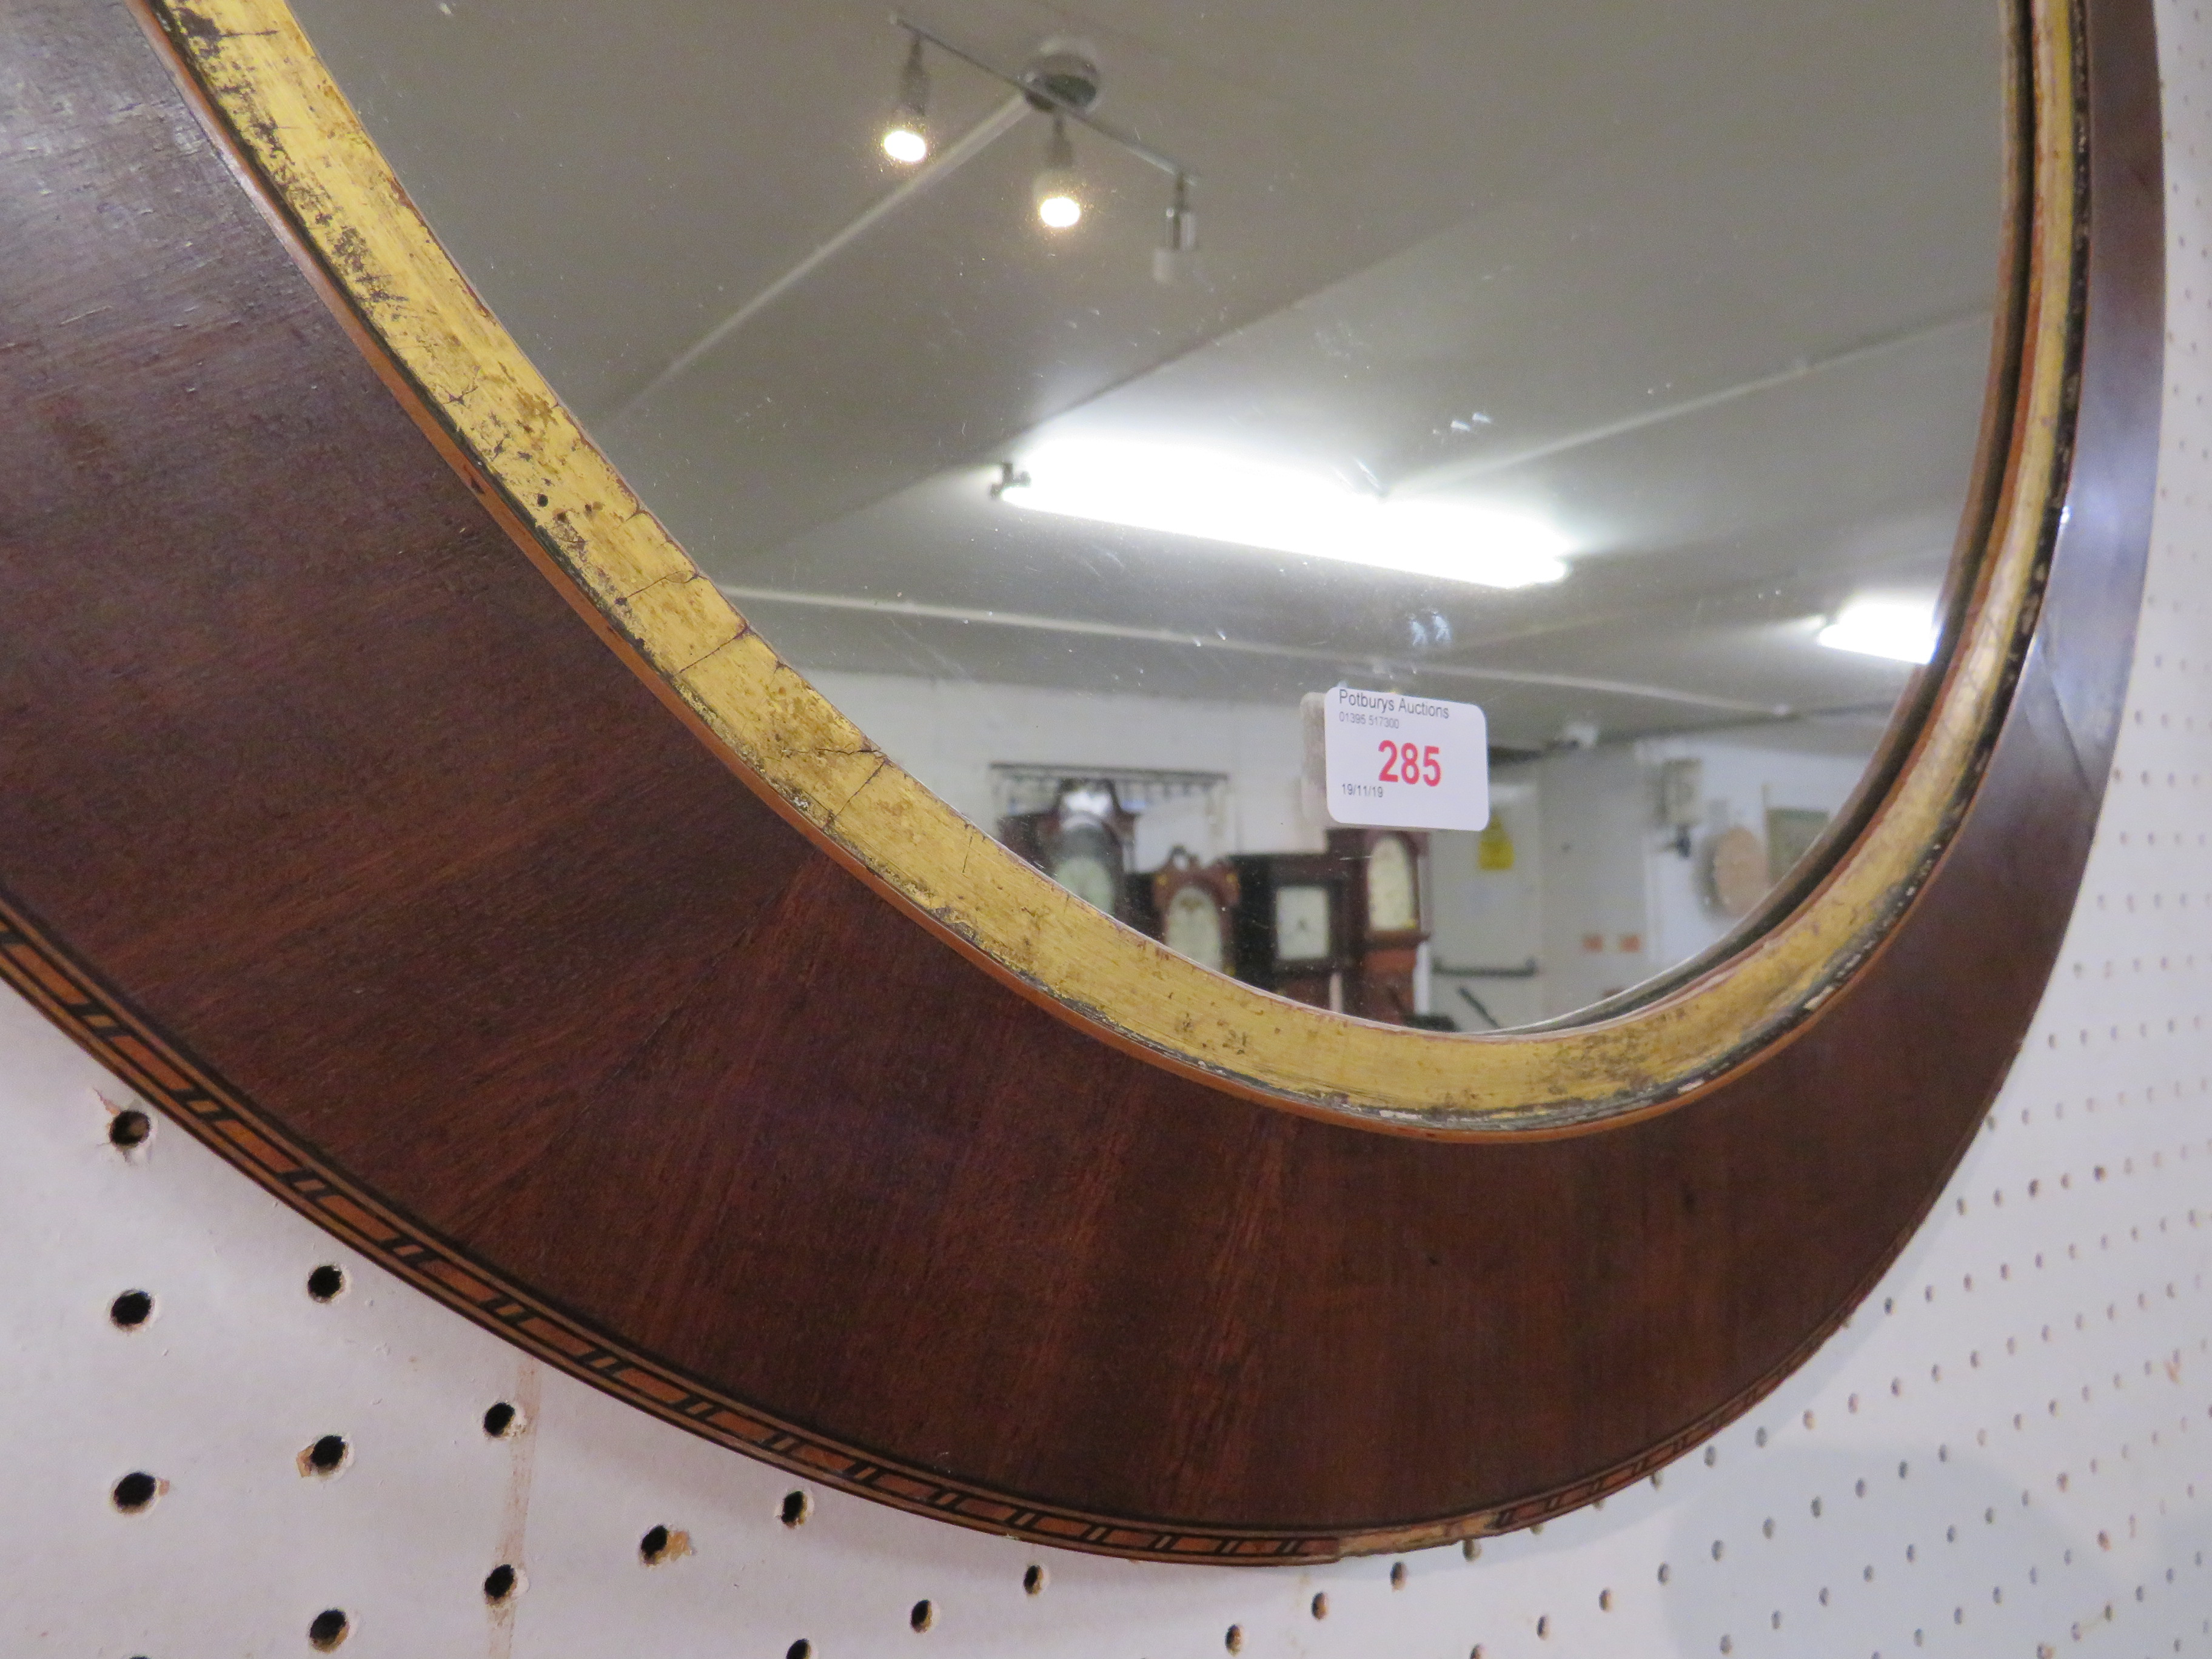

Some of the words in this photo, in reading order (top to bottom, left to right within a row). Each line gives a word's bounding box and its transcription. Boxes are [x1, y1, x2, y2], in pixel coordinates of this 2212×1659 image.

[1339, 689, 1395, 714] Potburys
[1398, 698, 1450, 719] Auctions
[1369, 716, 1400, 729] 517300
[1378, 740, 1441, 787] 285
[1342, 783, 1384, 798] 19/11/19
